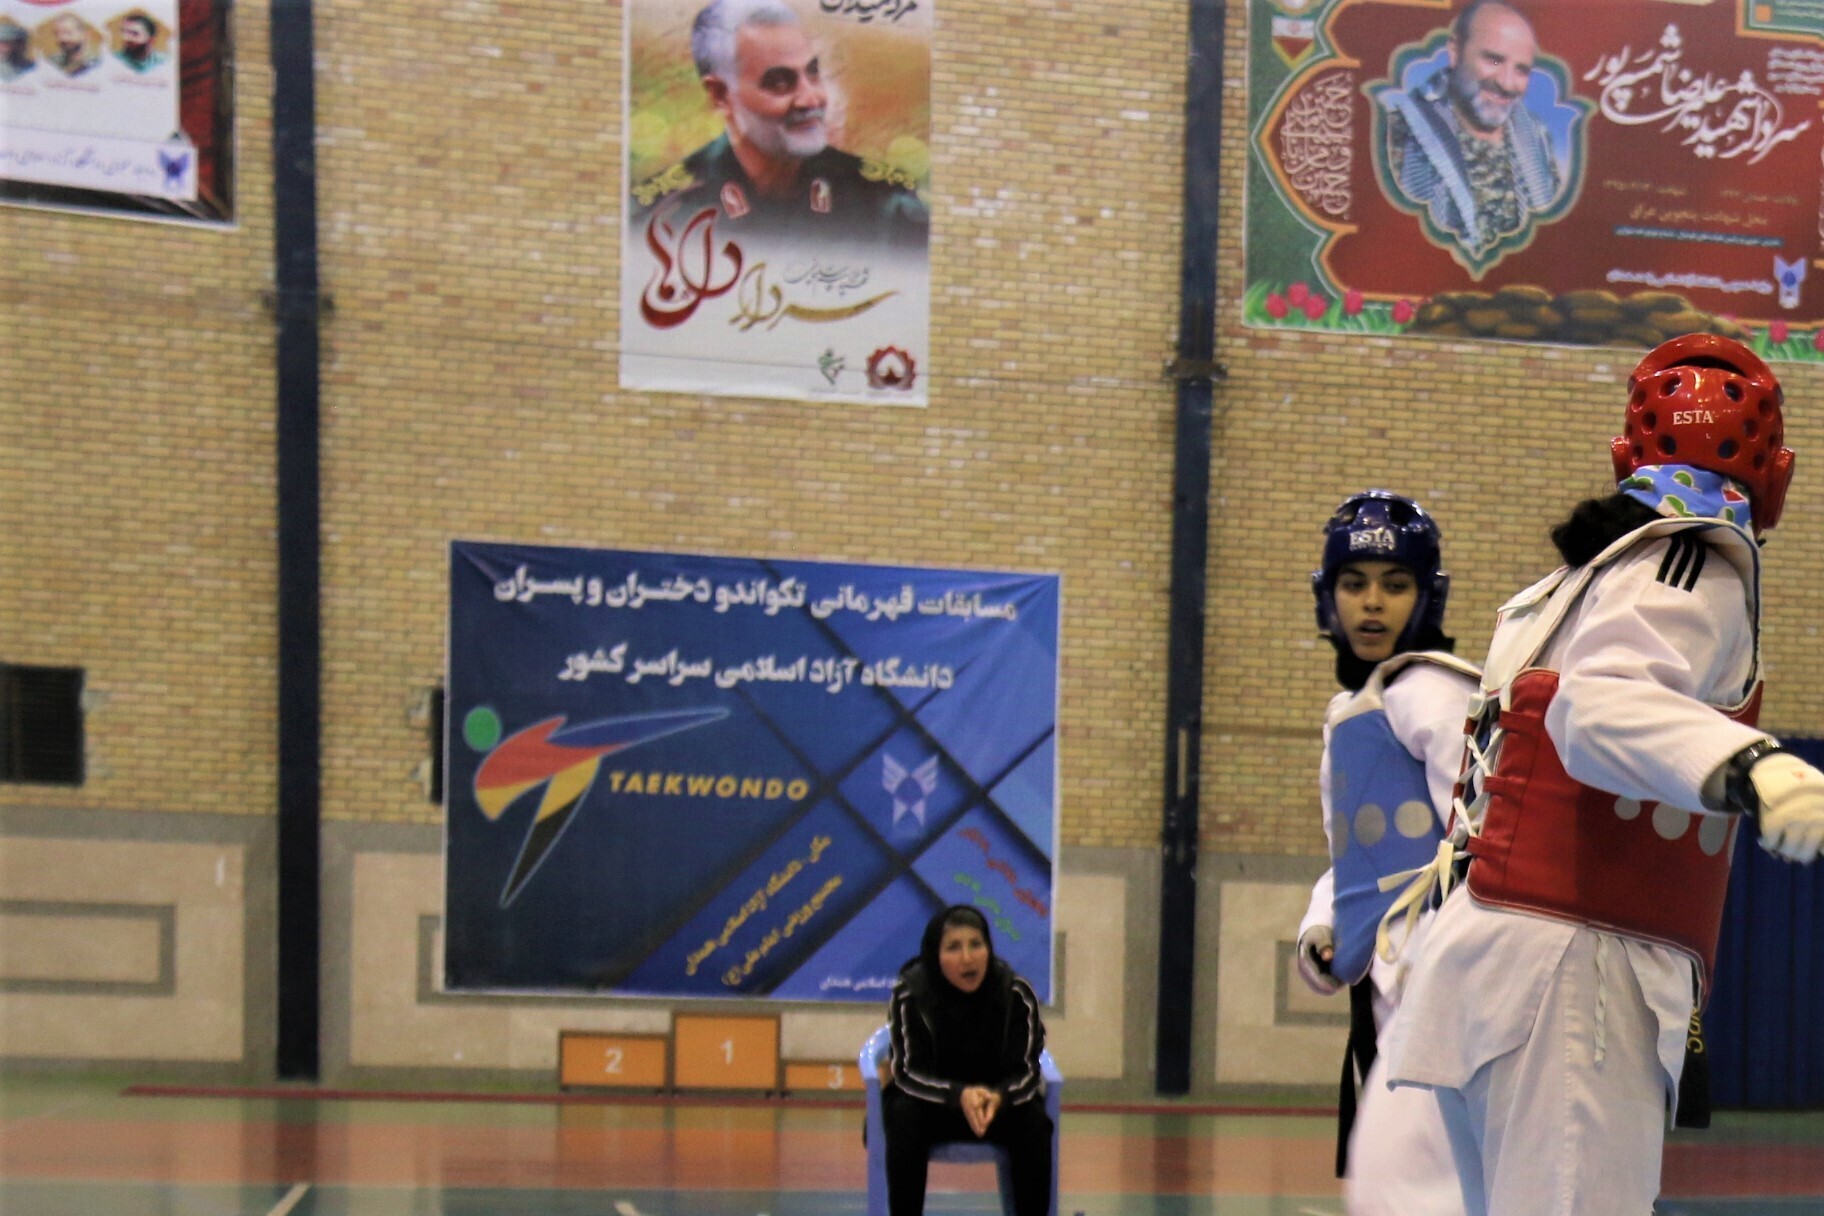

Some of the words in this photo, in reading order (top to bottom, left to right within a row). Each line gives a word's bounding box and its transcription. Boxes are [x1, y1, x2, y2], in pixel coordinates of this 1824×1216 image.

[1672, 410, 1714, 426] ESTA
[1349, 528, 1395, 551] ESTA
[493, 563, 584, 606] پسران
[586, 576, 603, 607] و
[605, 570, 712, 608] دختران
[713, 576, 807, 617] تکواندو
[810, 583, 915, 622] قهرمانی
[917, 589, 1018, 622] مسابقات
[556, 641, 629, 682] کشور
[625, 647, 713, 687] سراسر
[714, 654, 807, 689] اسلامی
[808, 656, 859, 694] آزاد
[860, 656, 954, 690] دانشگاه
[609, 770, 810, 802] TAEKWONDO
[604, 1047, 623, 1074] 2
[719, 1039, 735, 1066] 1
[827, 1064, 845, 1090] 3
